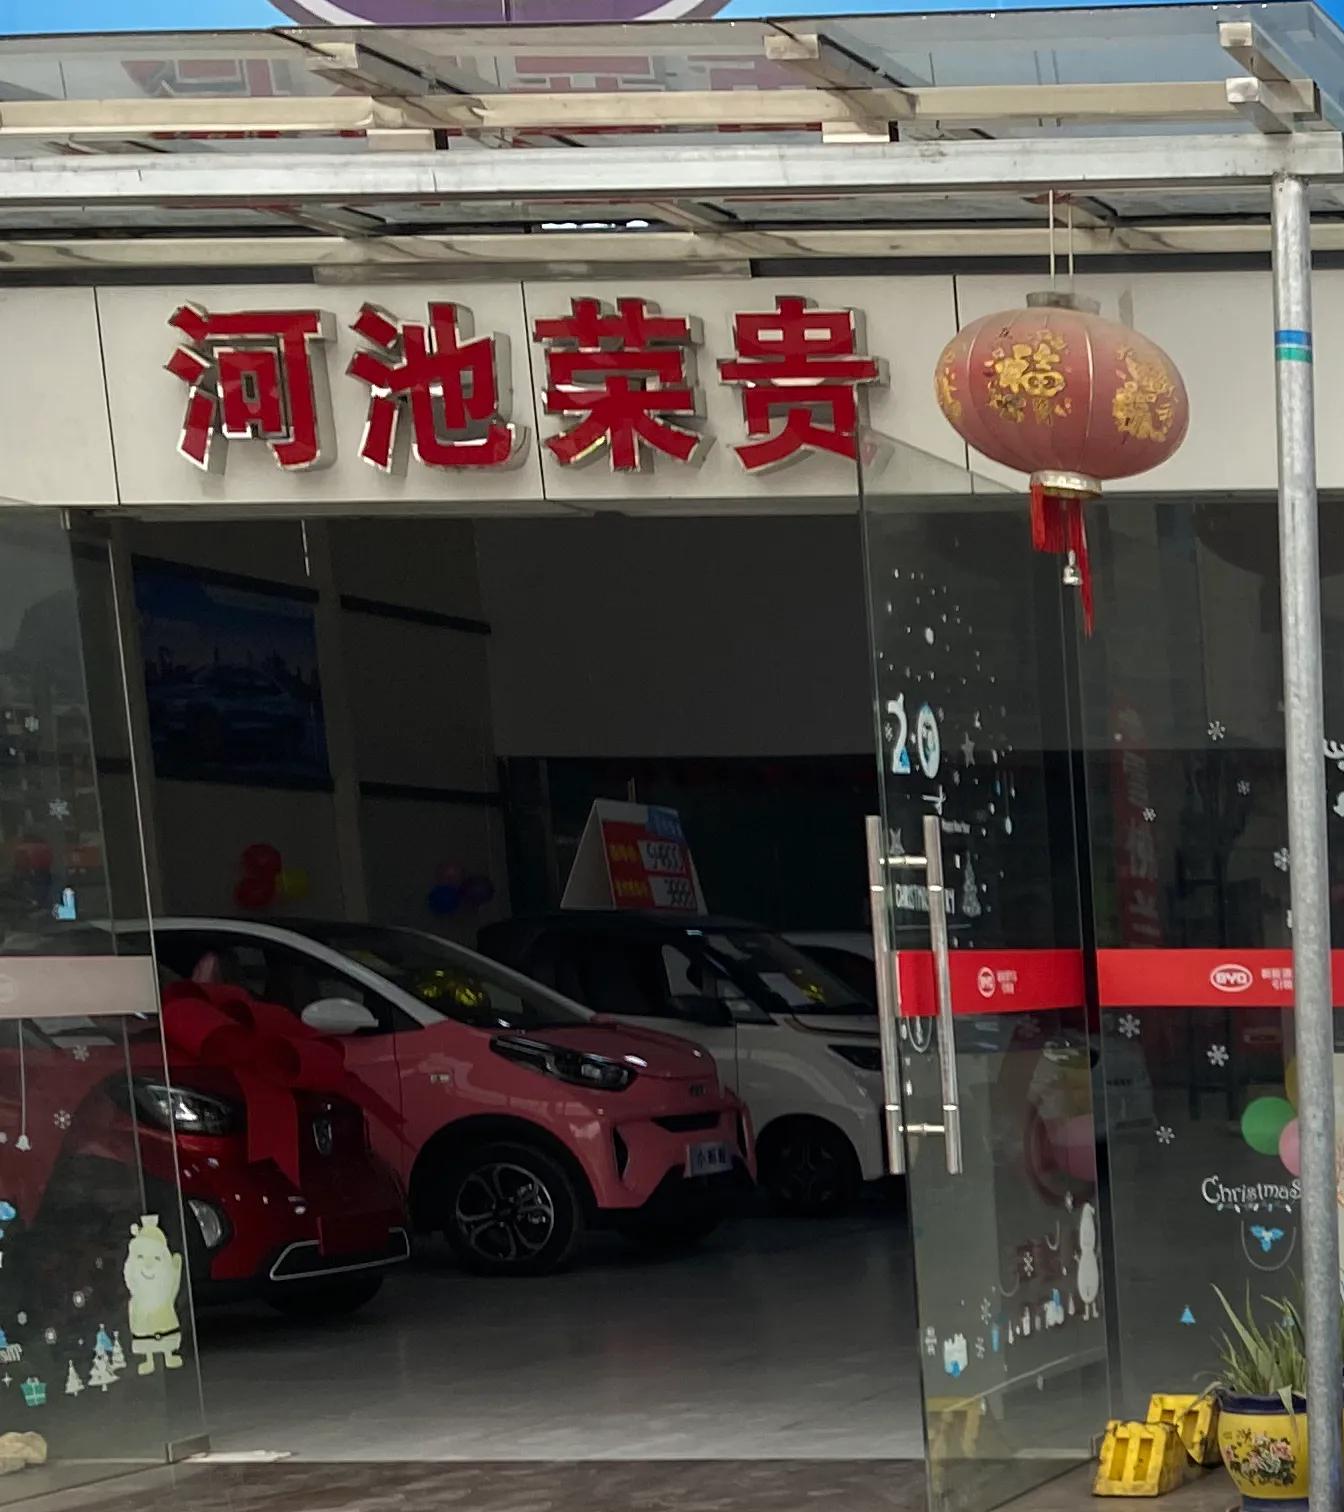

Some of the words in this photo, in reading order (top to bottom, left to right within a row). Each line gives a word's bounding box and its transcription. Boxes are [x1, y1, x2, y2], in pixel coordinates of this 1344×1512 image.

[164, 296, 880, 475] 河池荣贵
[1202, 1175, 1302, 1204] Christmas
